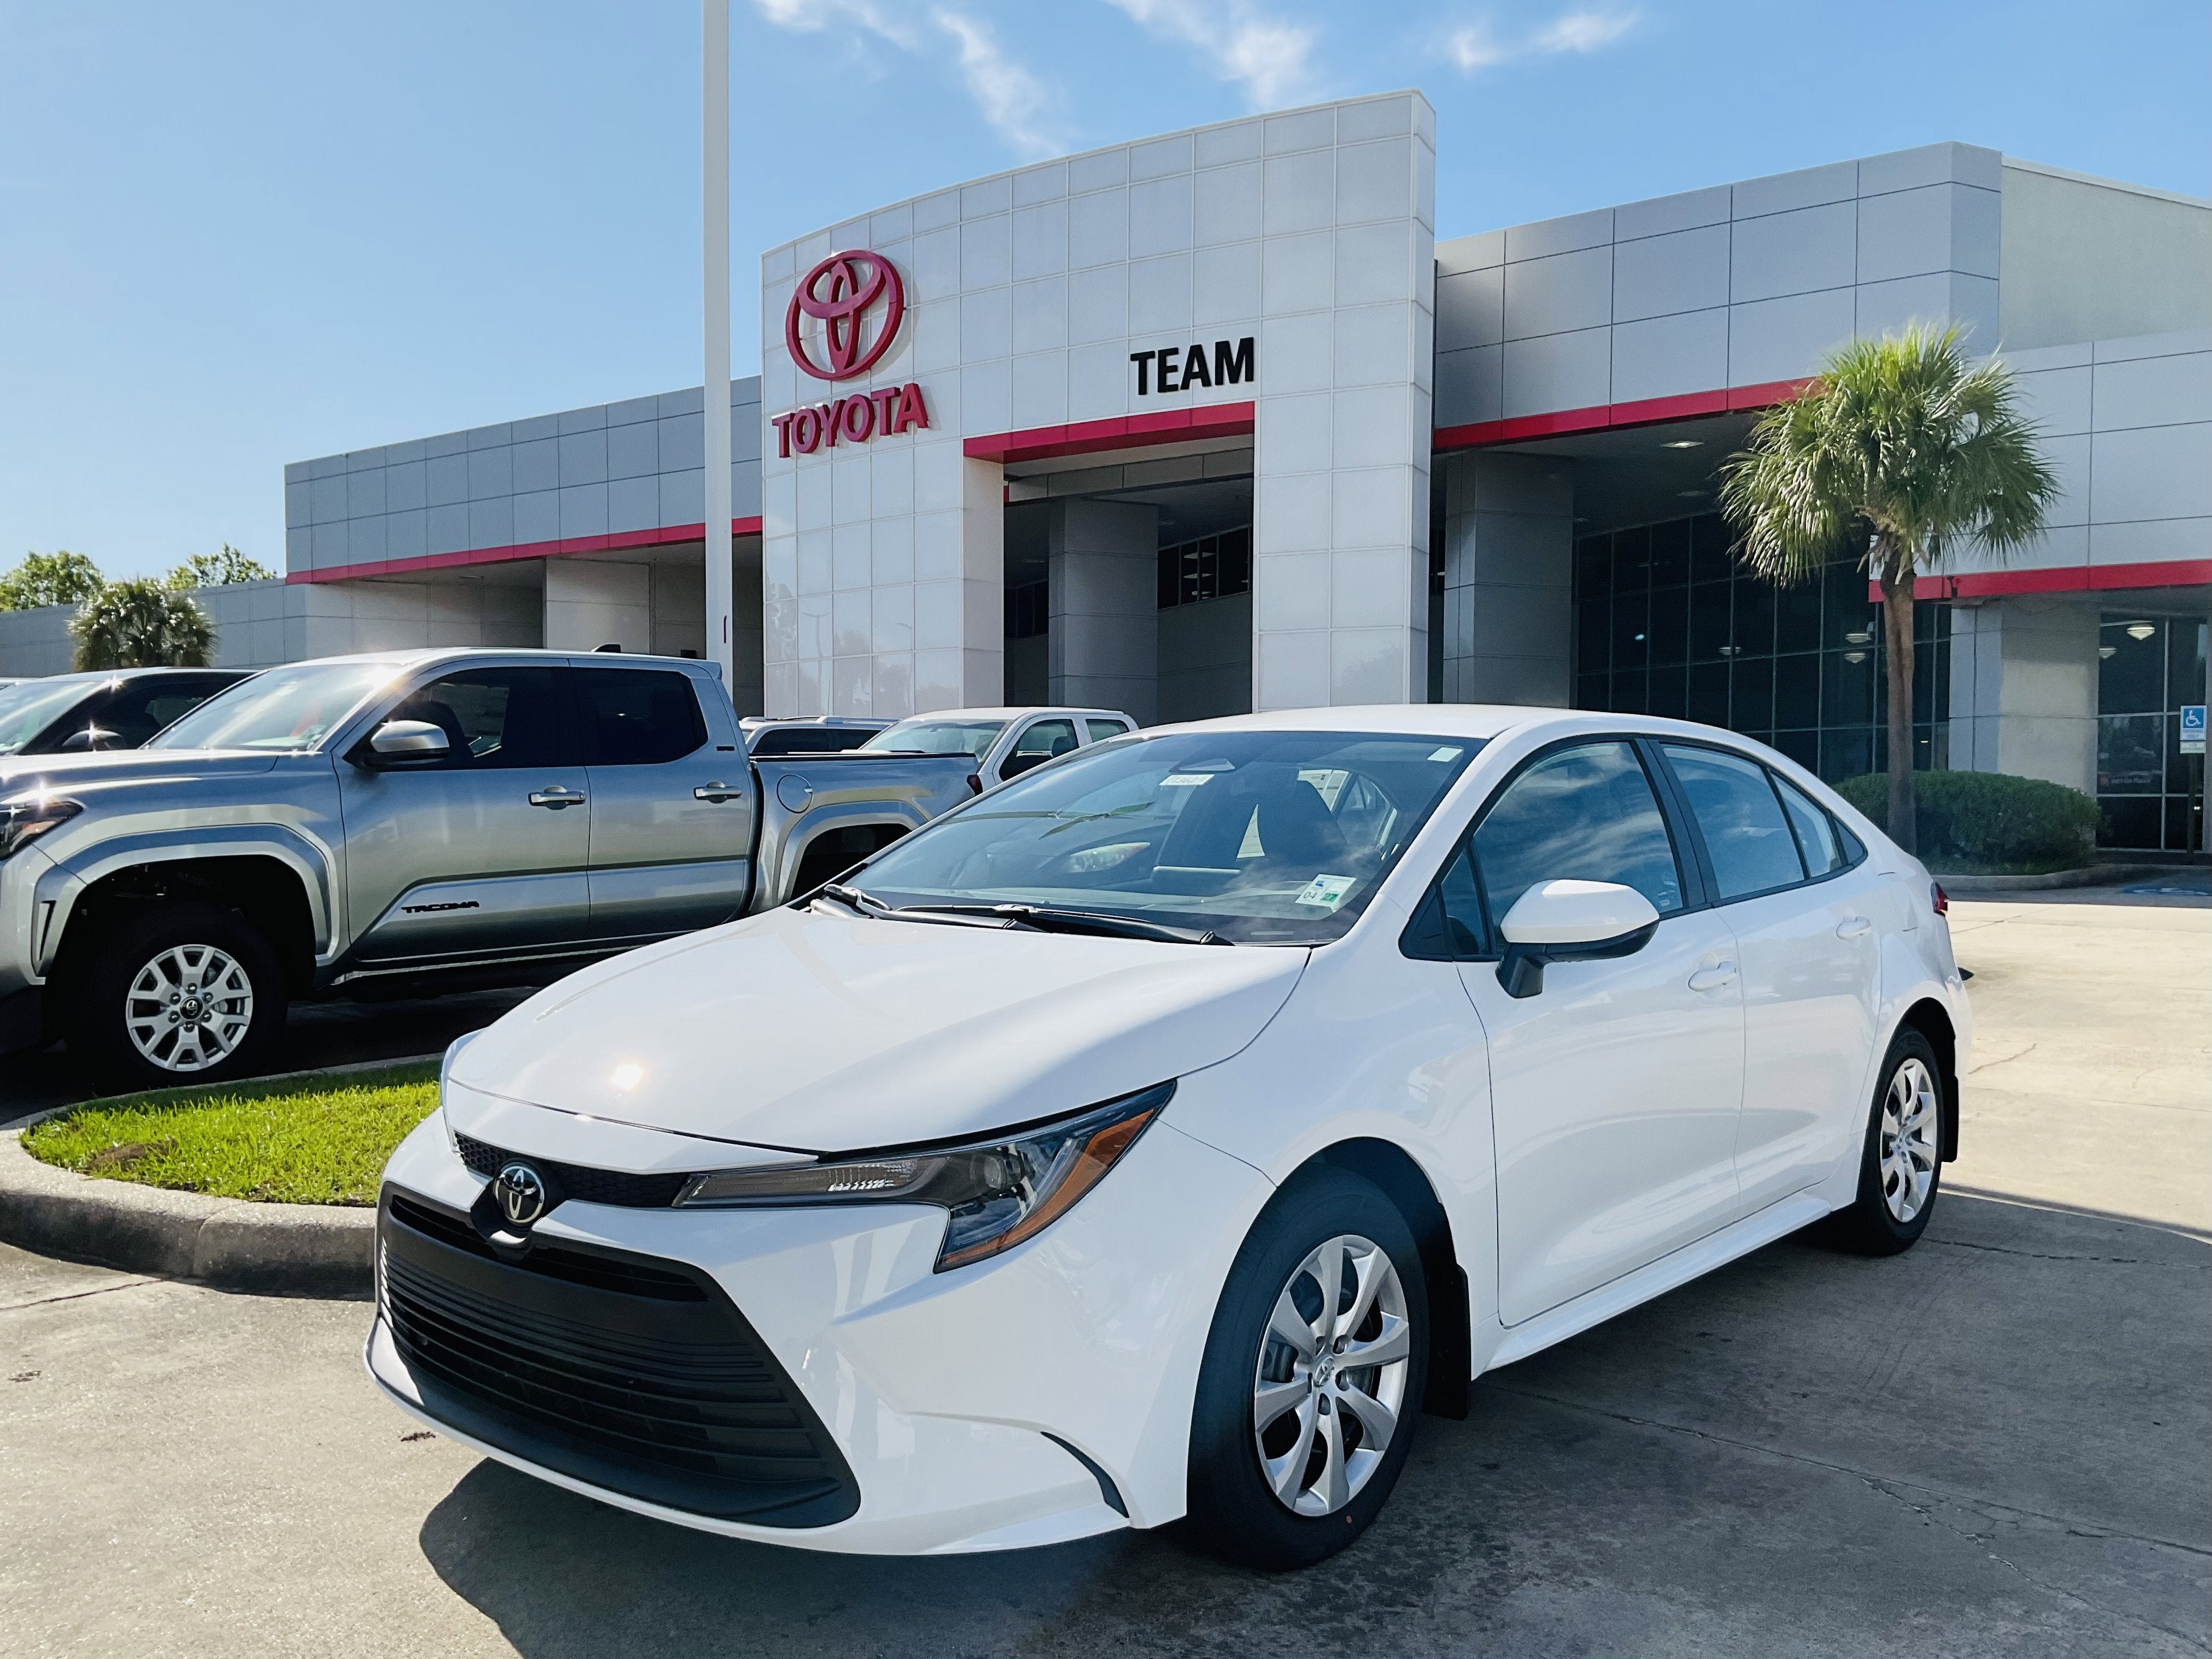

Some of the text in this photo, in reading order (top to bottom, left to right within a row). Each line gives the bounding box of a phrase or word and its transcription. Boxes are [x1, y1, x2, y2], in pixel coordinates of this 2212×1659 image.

[1130, 337, 1254, 395] TEAM
[772, 382, 930, 458] TOYOTA
[401, 901, 479, 913] TACOMA
